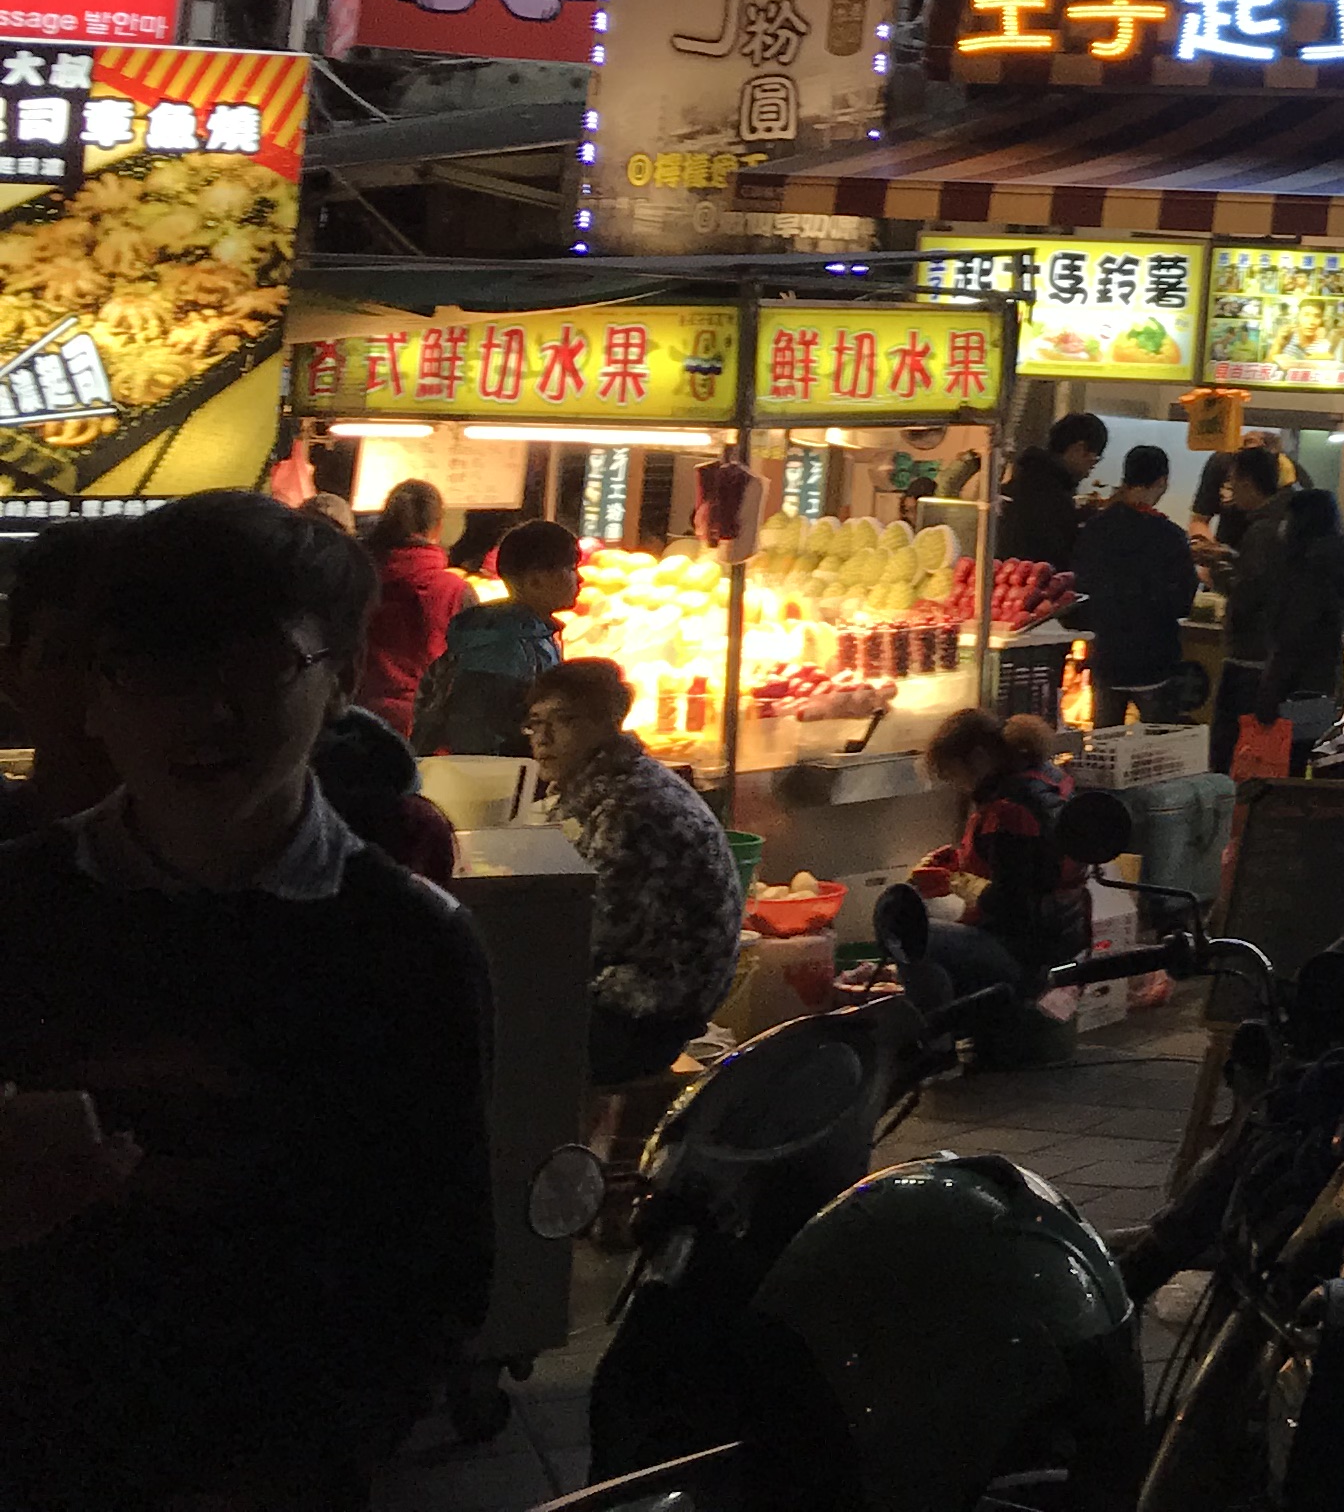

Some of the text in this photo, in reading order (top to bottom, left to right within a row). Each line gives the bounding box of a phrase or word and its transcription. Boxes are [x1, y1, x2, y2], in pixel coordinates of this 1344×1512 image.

[0, 96, 262, 153] 司章魚燒
[307, 322, 651, 407] 各式鮮切水果
[769, 326, 992, 402] 鮮切水果
